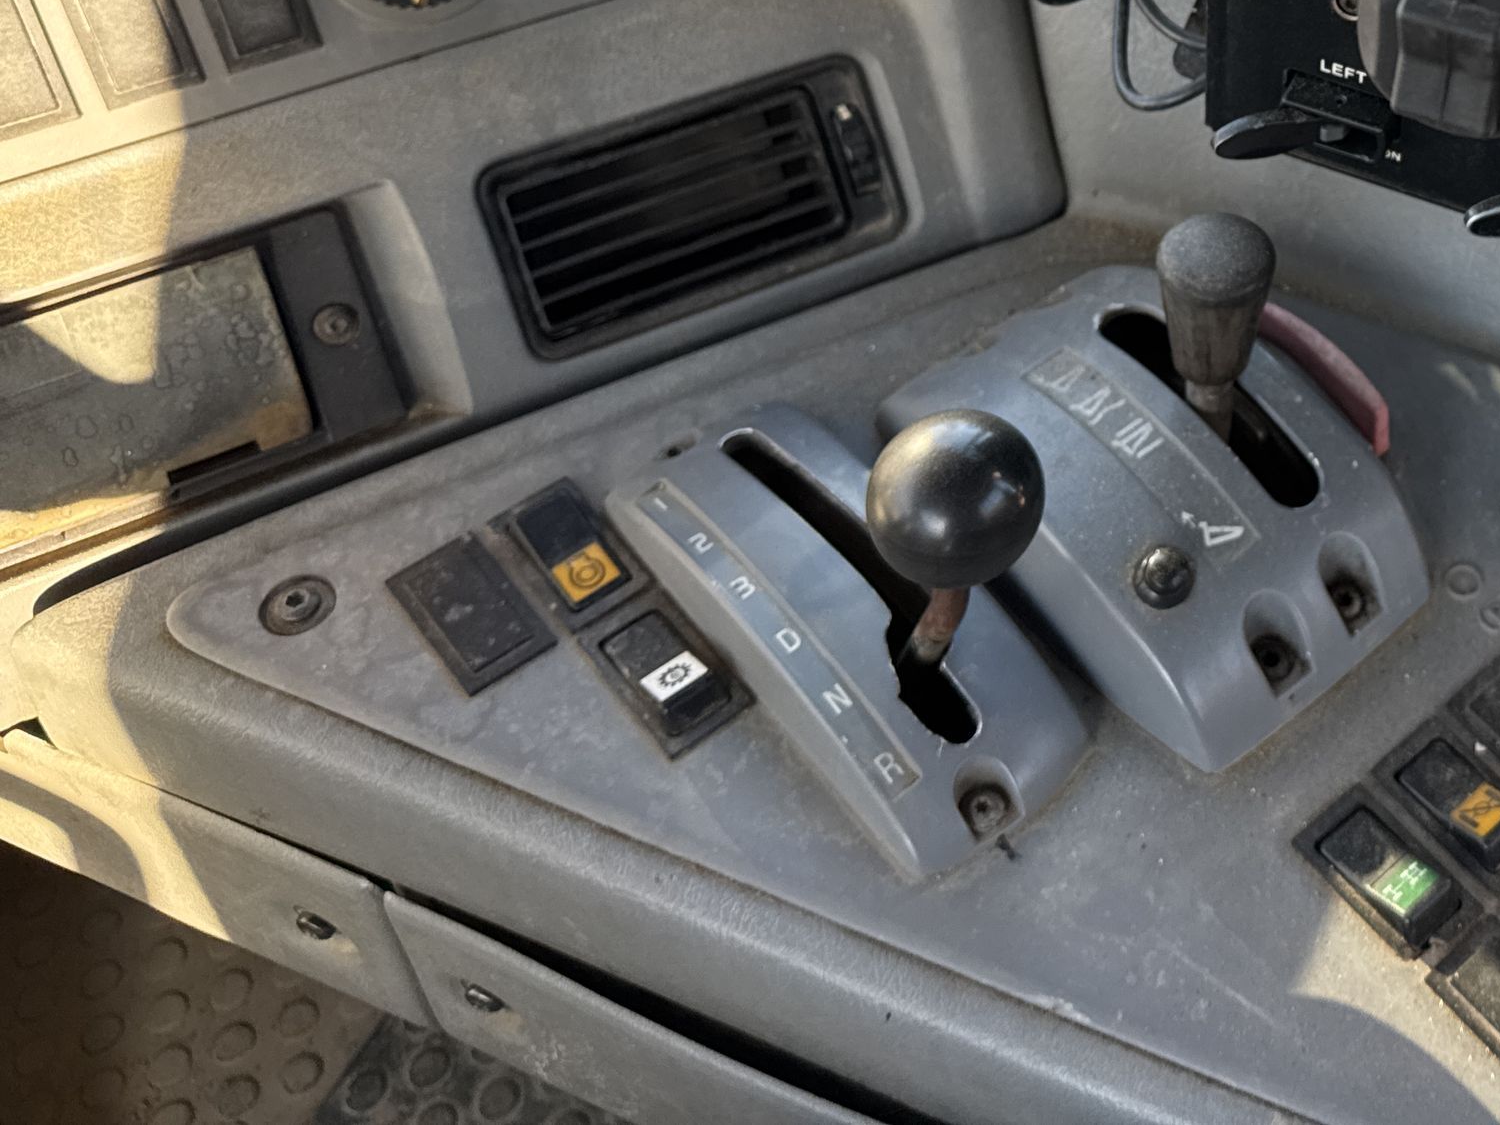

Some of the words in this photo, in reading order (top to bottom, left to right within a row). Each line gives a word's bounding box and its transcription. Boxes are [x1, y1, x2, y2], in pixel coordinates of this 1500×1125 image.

[1320, 59, 1367, 84] LEFT
[775, 626, 801, 654] D
[822, 682, 854, 715] N
[873, 752, 904, 784] R
